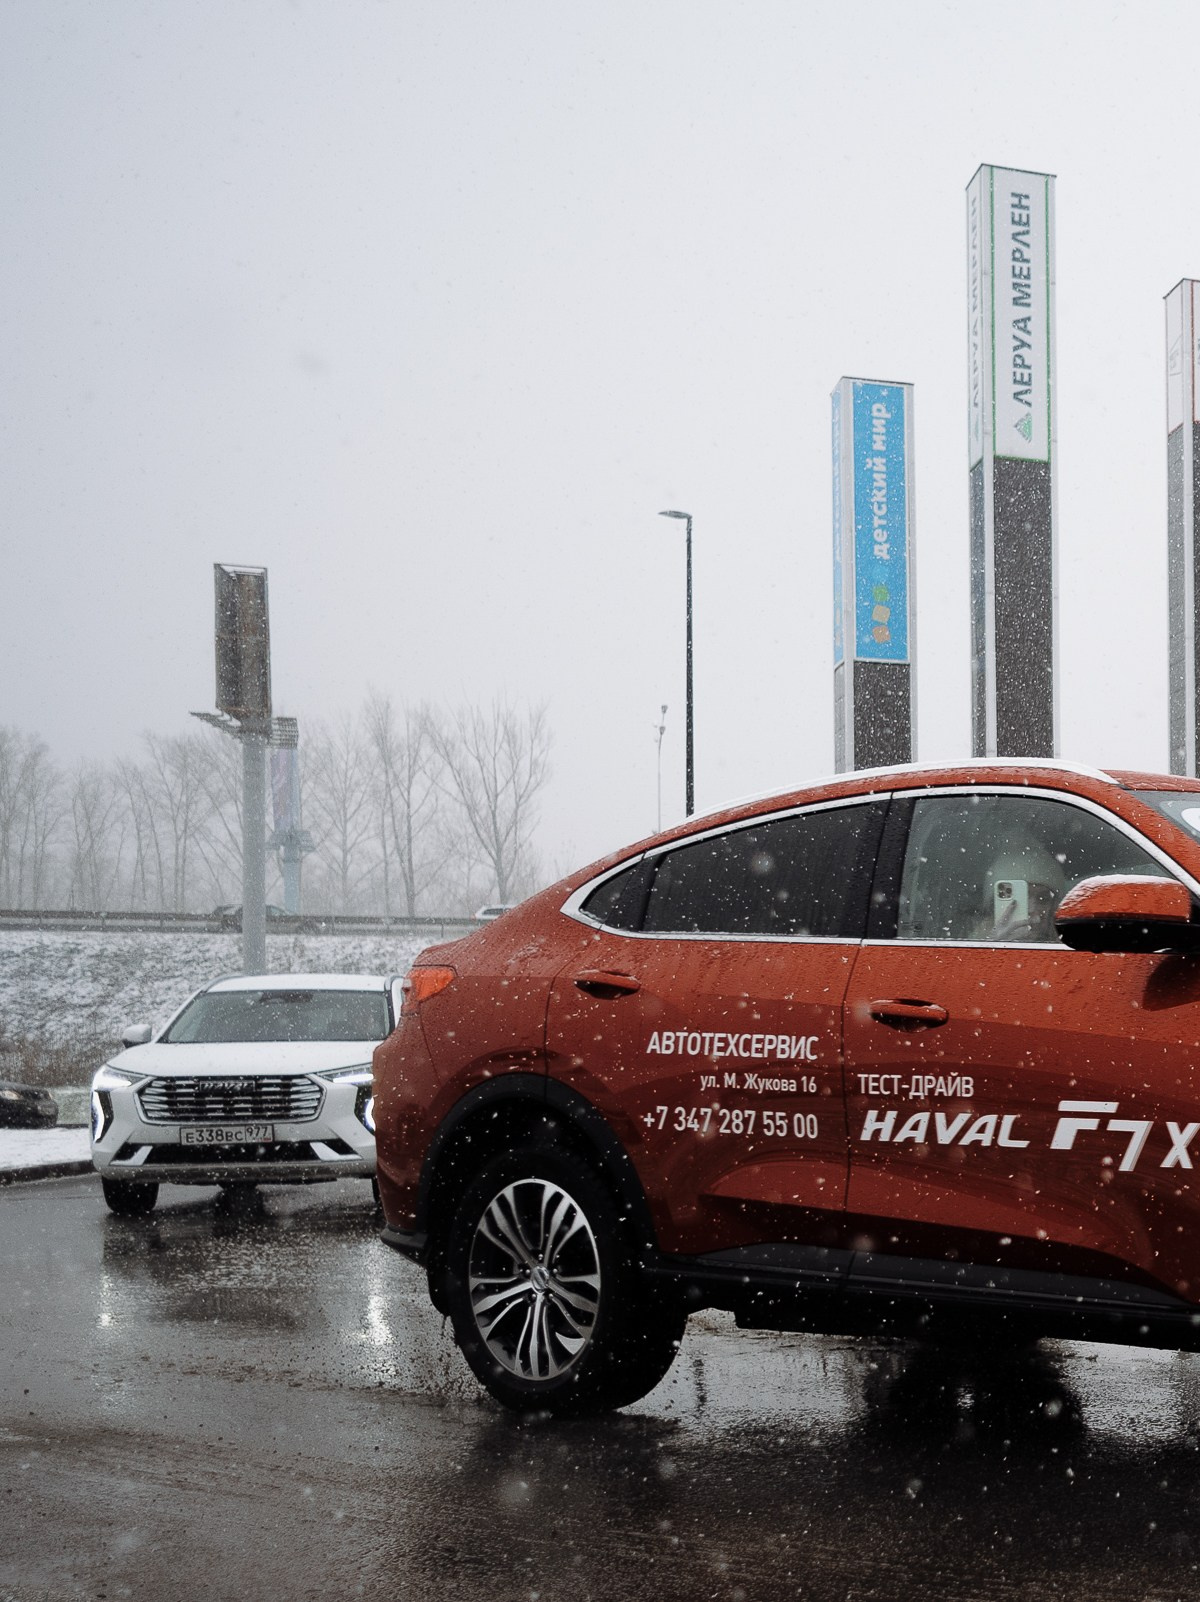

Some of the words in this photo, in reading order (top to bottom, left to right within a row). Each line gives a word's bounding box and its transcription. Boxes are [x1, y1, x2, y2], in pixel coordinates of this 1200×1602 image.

[1010, 191, 1032, 308] МЕРЛЕН
[1012, 315, 1032, 408] ЛЕРУА
[871, 402, 892, 451] мир
[866, 457, 890, 560] детский
[646, 1031, 819, 1060] АВТОТЕХСЕРВИС
[700, 1074, 720, 1091] ул.
[724, 1073, 741, 1089] М.
[743, 1073, 797, 1094] Жукова
[801, 1075, 817, 1093] 16
[858, 1073, 974, 1100] ТЕСТ-ДРАЙВ
[643, 1105, 668, 1130] +7
[673, 1106, 712, 1132] 347
[718, 1108, 757, 1135] 287
[762, 1111, 788, 1137] 55
[793, 1113, 818, 1139] 00
[860, 1109, 1031, 1149] HAVAL
